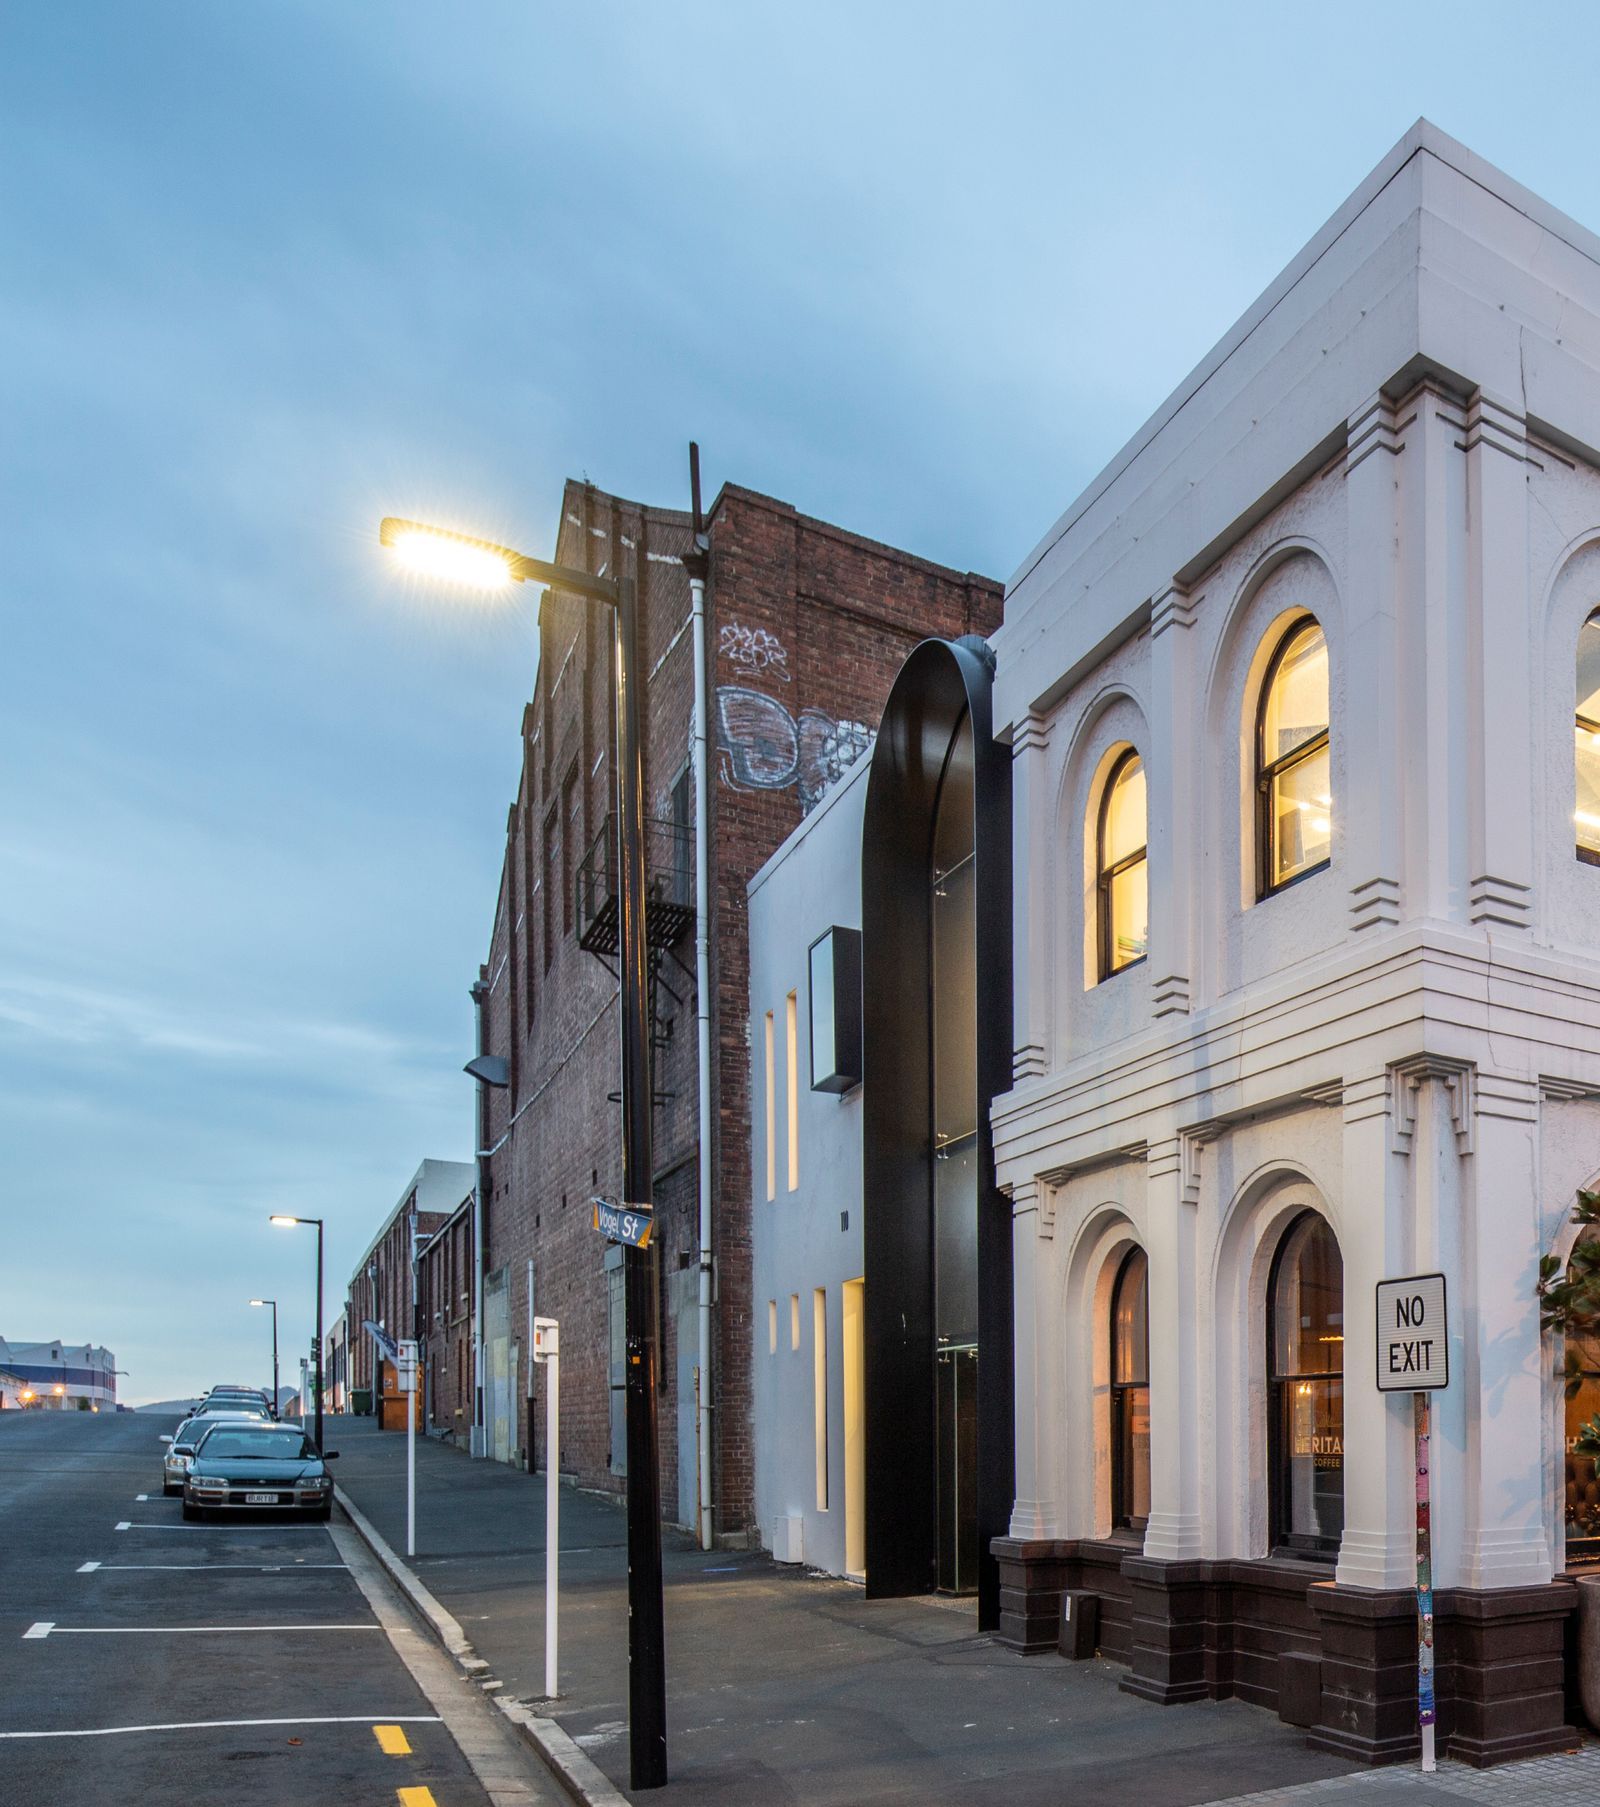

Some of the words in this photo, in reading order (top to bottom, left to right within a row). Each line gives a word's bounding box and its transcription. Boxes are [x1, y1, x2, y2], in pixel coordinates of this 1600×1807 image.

[600, 1204, 620, 1235] Vogel
[622, 1215, 639, 1240] St
[1396, 1295, 1424, 1328] NO
[1389, 1340, 1433, 1373] EXIT
[1295, 1436, 1344, 1454] HERITA
[1313, 1458, 1340, 1467] COFFEE
